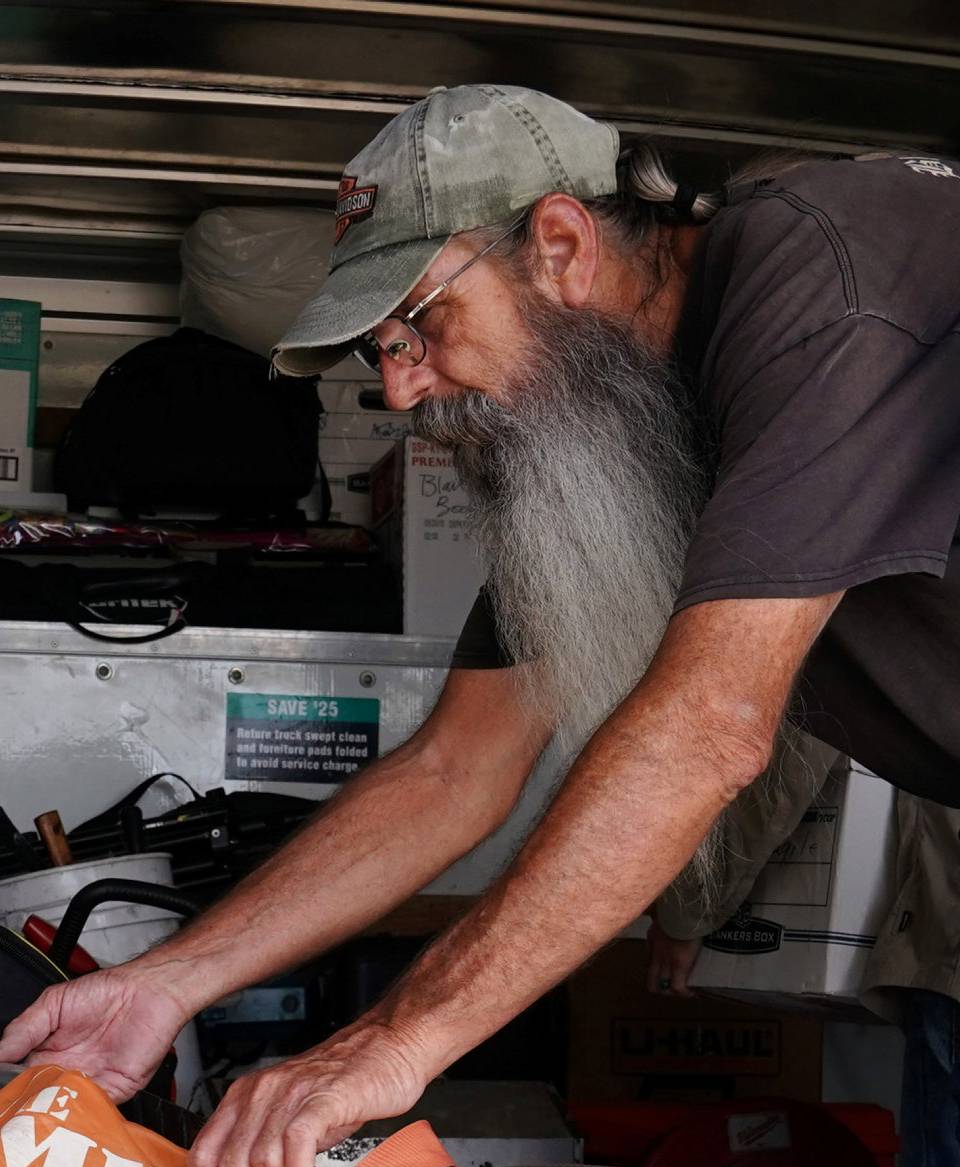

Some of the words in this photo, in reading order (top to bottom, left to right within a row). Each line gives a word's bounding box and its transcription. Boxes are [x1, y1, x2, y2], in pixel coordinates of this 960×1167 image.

[267, 699, 307, 717] SAVE
[236, 727, 272, 740] Return
[275, 729, 302, 741] truck
[304, 730, 336, 743] swept
[338, 731, 367, 743] clean
[236, 743, 256, 754] and
[259, 743, 305, 755] furniture
[307, 746, 333, 758] pads
[335, 745, 368, 758] folded
[236, 757, 248, 768] to
[250, 757, 279, 769] avoid
[282, 758, 320, 771] service
[754, 930, 775, 943] BOX
[621, 1028, 774, 1056] U-HAUL
